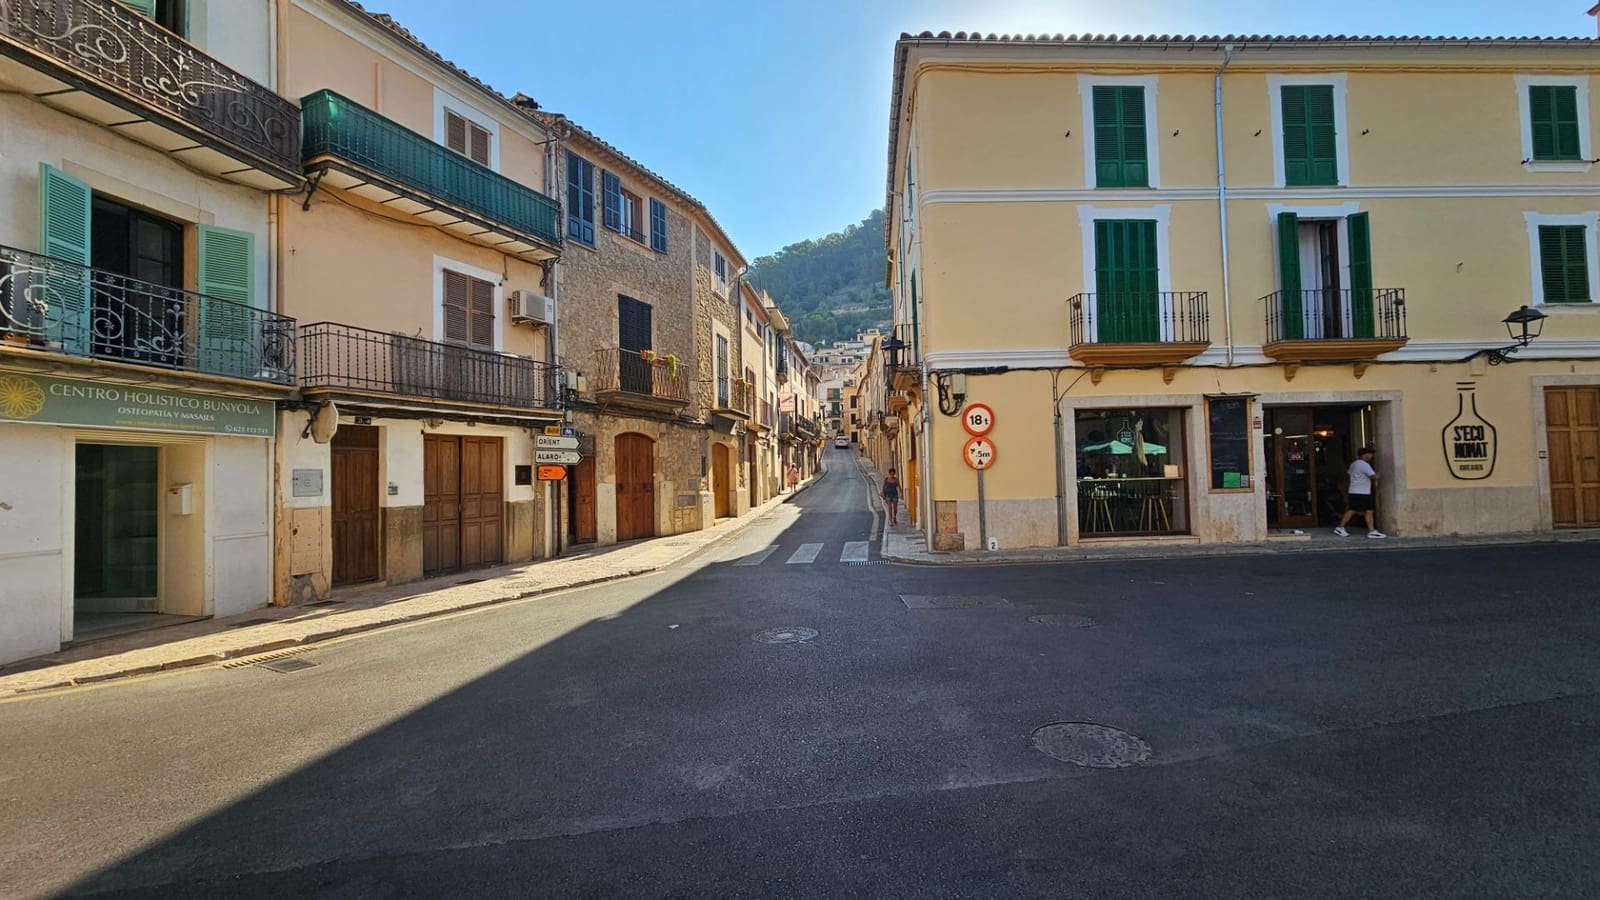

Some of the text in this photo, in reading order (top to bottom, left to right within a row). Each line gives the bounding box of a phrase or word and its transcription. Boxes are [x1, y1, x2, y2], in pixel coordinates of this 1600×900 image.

[50, 383, 260, 416] CENTRO HOLISTICO BUNYOLA
[181, 412, 215, 421] MASAJES
[969, 415, 989, 425] 18 t
[1454, 442, 1488, 458] NOMAT
